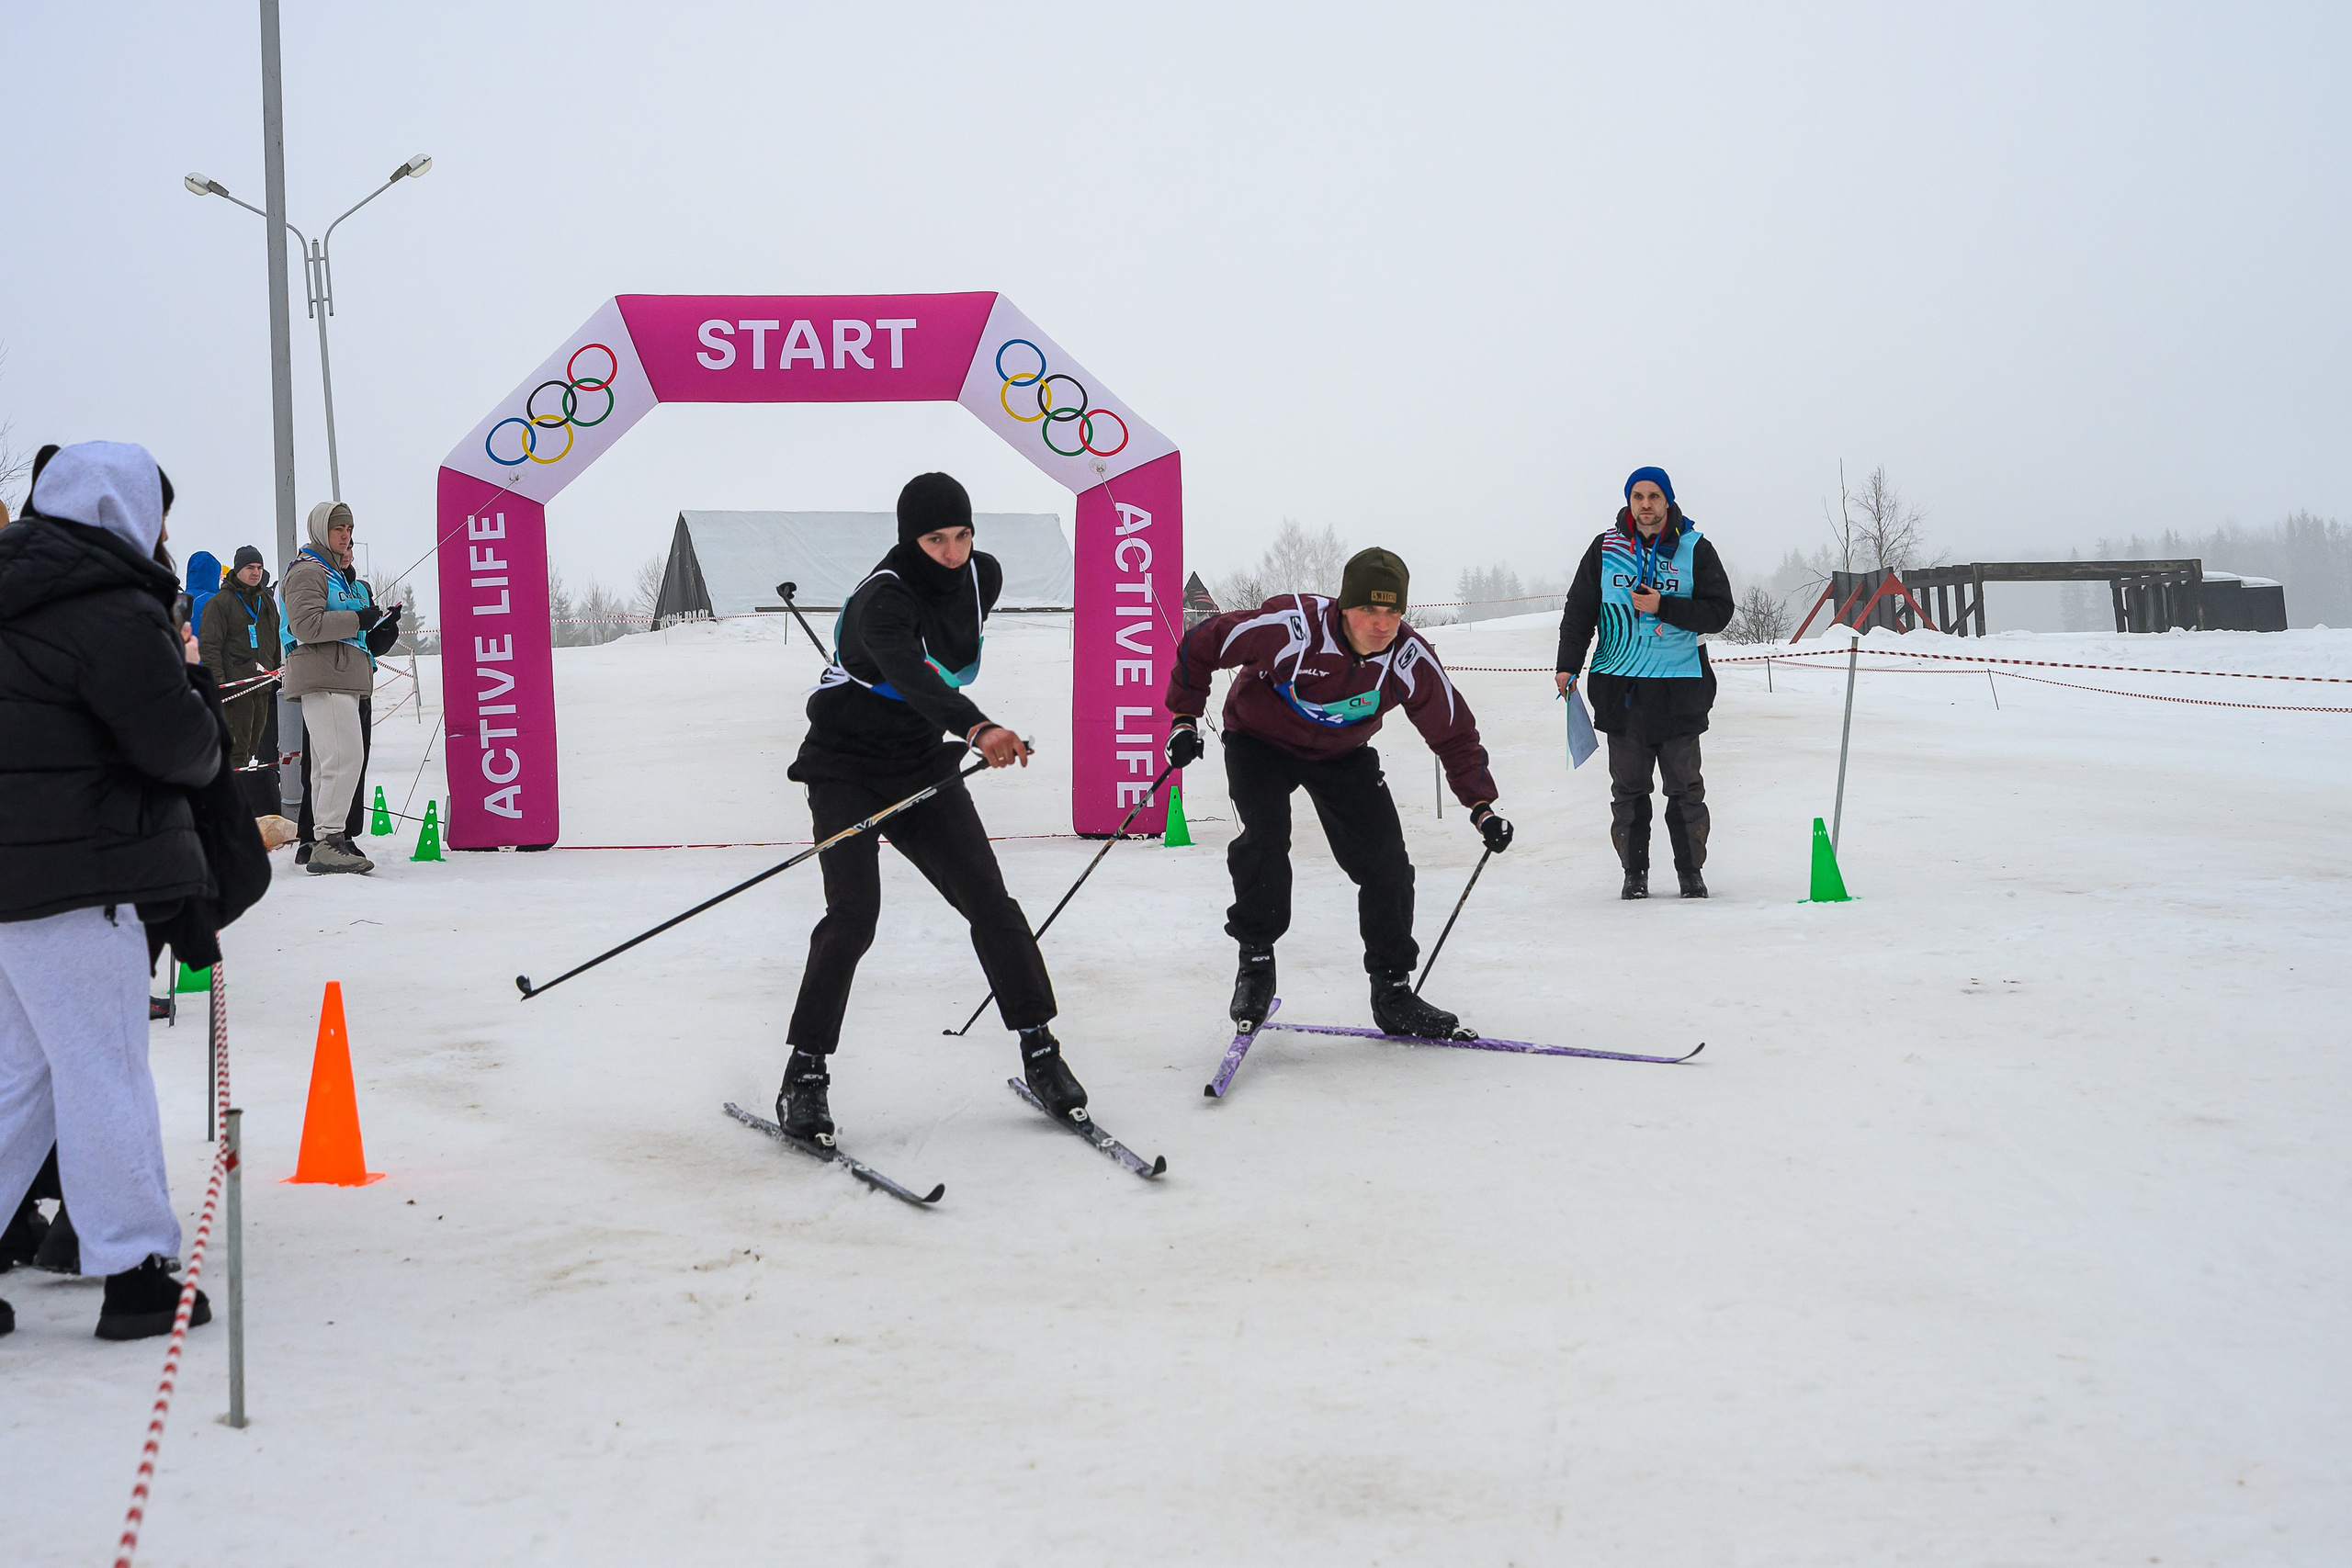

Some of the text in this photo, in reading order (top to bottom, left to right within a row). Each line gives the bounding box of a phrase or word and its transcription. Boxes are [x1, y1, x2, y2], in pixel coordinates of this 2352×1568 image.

[695, 318, 917, 370] START
[467, 512, 523, 819] ACTIVE LIFE
[1114, 502, 1153, 686] ACTIVE
[1115, 706, 1155, 808] LIFE
